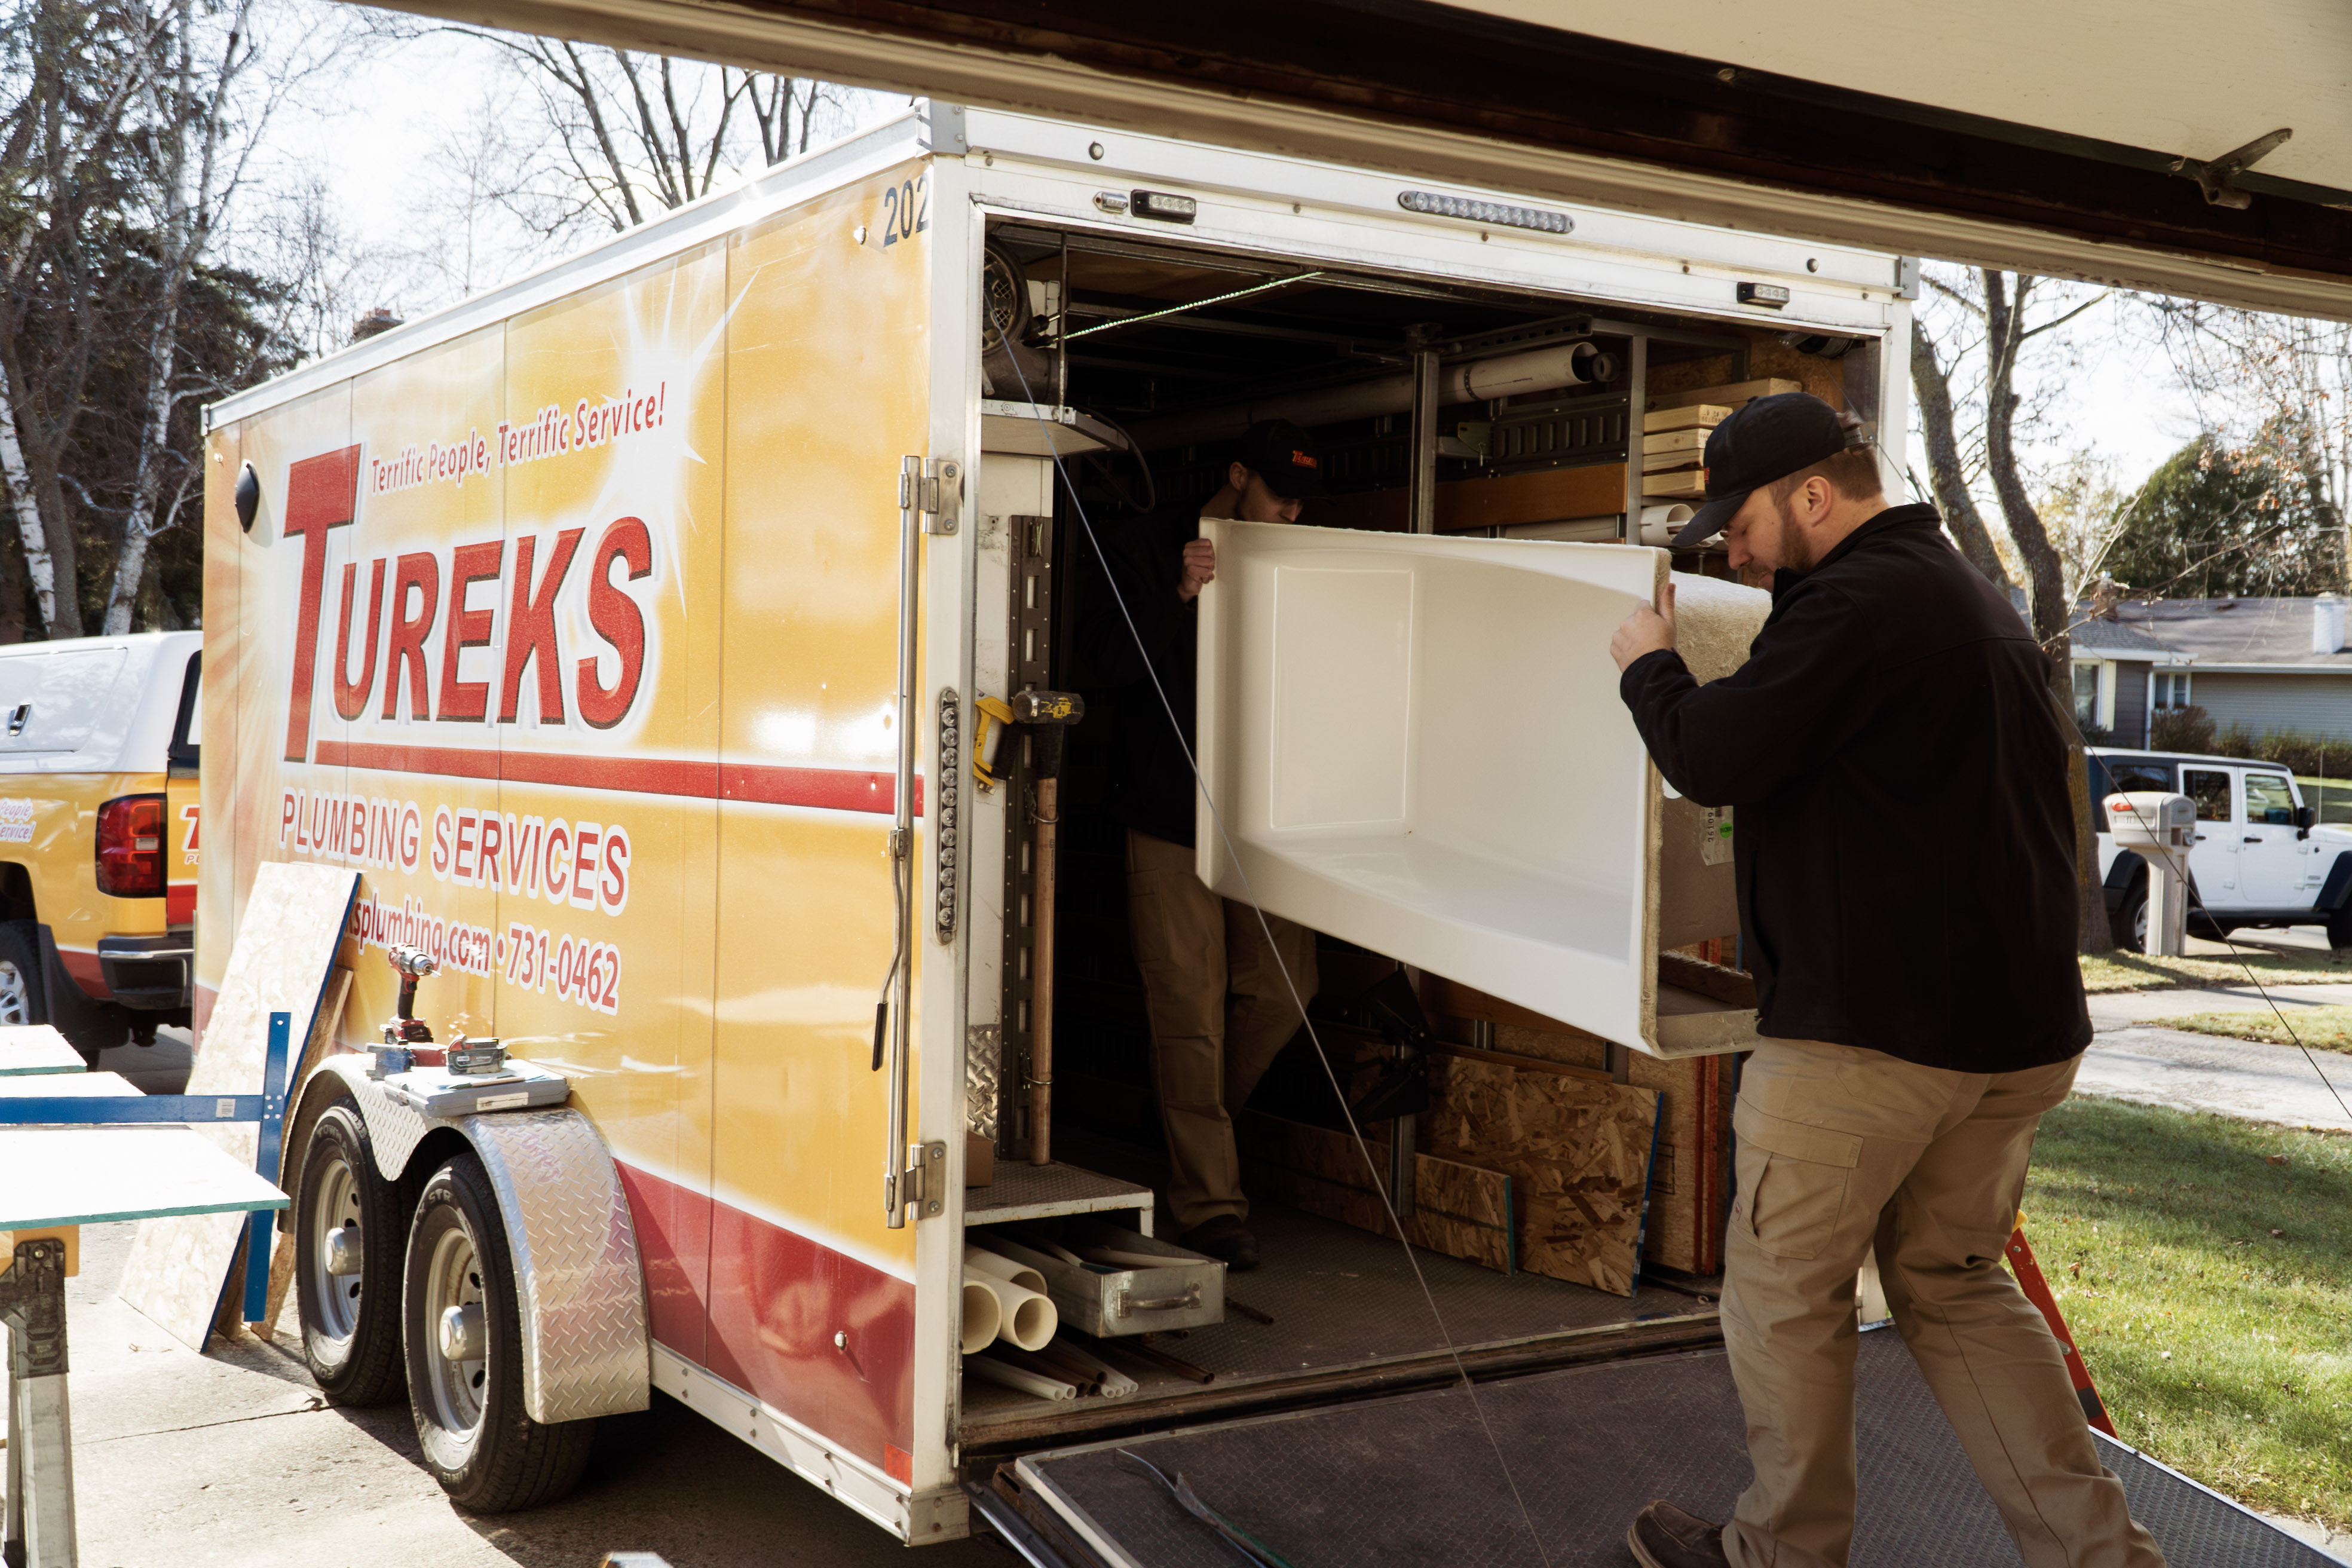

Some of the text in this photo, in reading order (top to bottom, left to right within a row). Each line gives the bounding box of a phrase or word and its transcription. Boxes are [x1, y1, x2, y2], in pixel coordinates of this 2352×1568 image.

[883, 173, 929, 247] 202
[372, 381, 666, 493] Terrific People, Terrific Service!
[283, 442, 653, 764] TUREKS
[0, 801, 32, 819] People,
[281, 793, 419, 868] PLUMBING
[433, 812, 628, 906] SERVICES
[508, 927, 618, 1009] 731-0462
